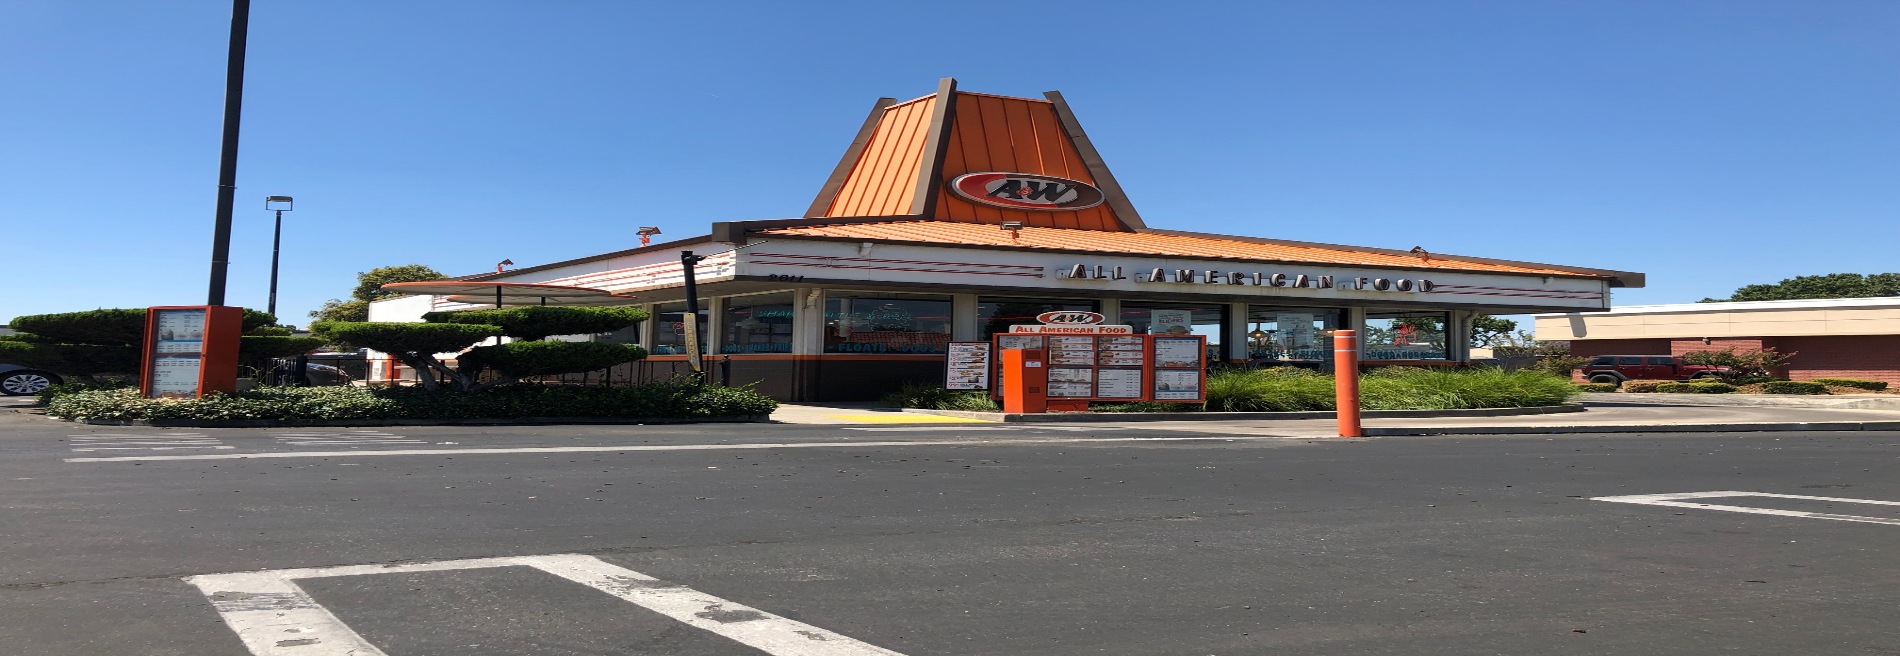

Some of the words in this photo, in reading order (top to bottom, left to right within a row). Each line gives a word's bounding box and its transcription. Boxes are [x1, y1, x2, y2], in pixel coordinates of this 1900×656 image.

[985, 179, 1077, 202] A&W
[1068, 264, 1126, 280] ALL
[1148, 268, 1334, 289] AMERICAN
[1354, 277, 1434, 292] FOOD
[1051, 314, 1093, 323] A&W
